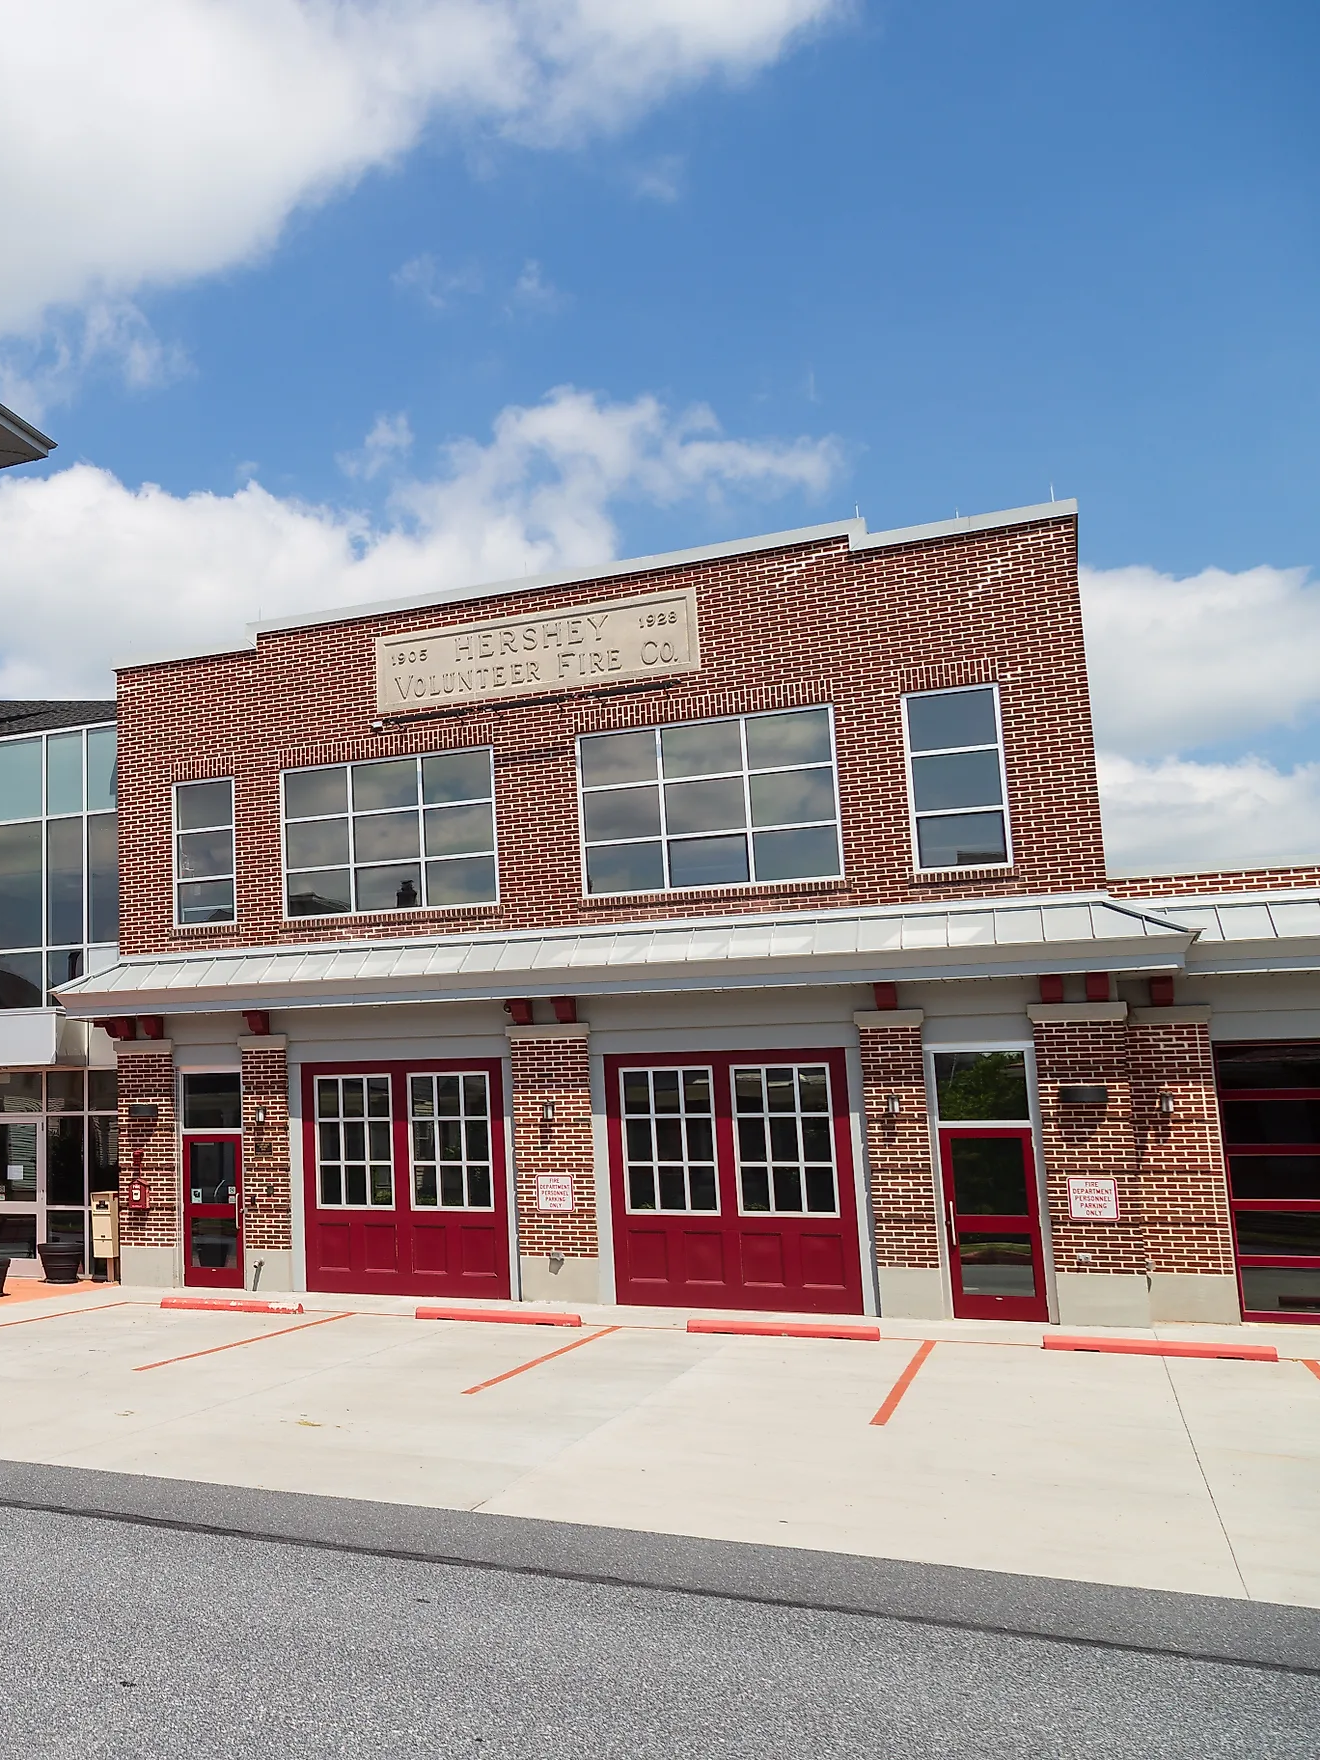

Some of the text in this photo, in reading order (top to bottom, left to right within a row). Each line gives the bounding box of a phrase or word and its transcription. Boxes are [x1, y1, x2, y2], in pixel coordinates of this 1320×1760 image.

[454, 614, 608, 662] HERSHEY
[394, 661, 541, 700] VOLUNTEER
[557, 649, 622, 679] FIRE
